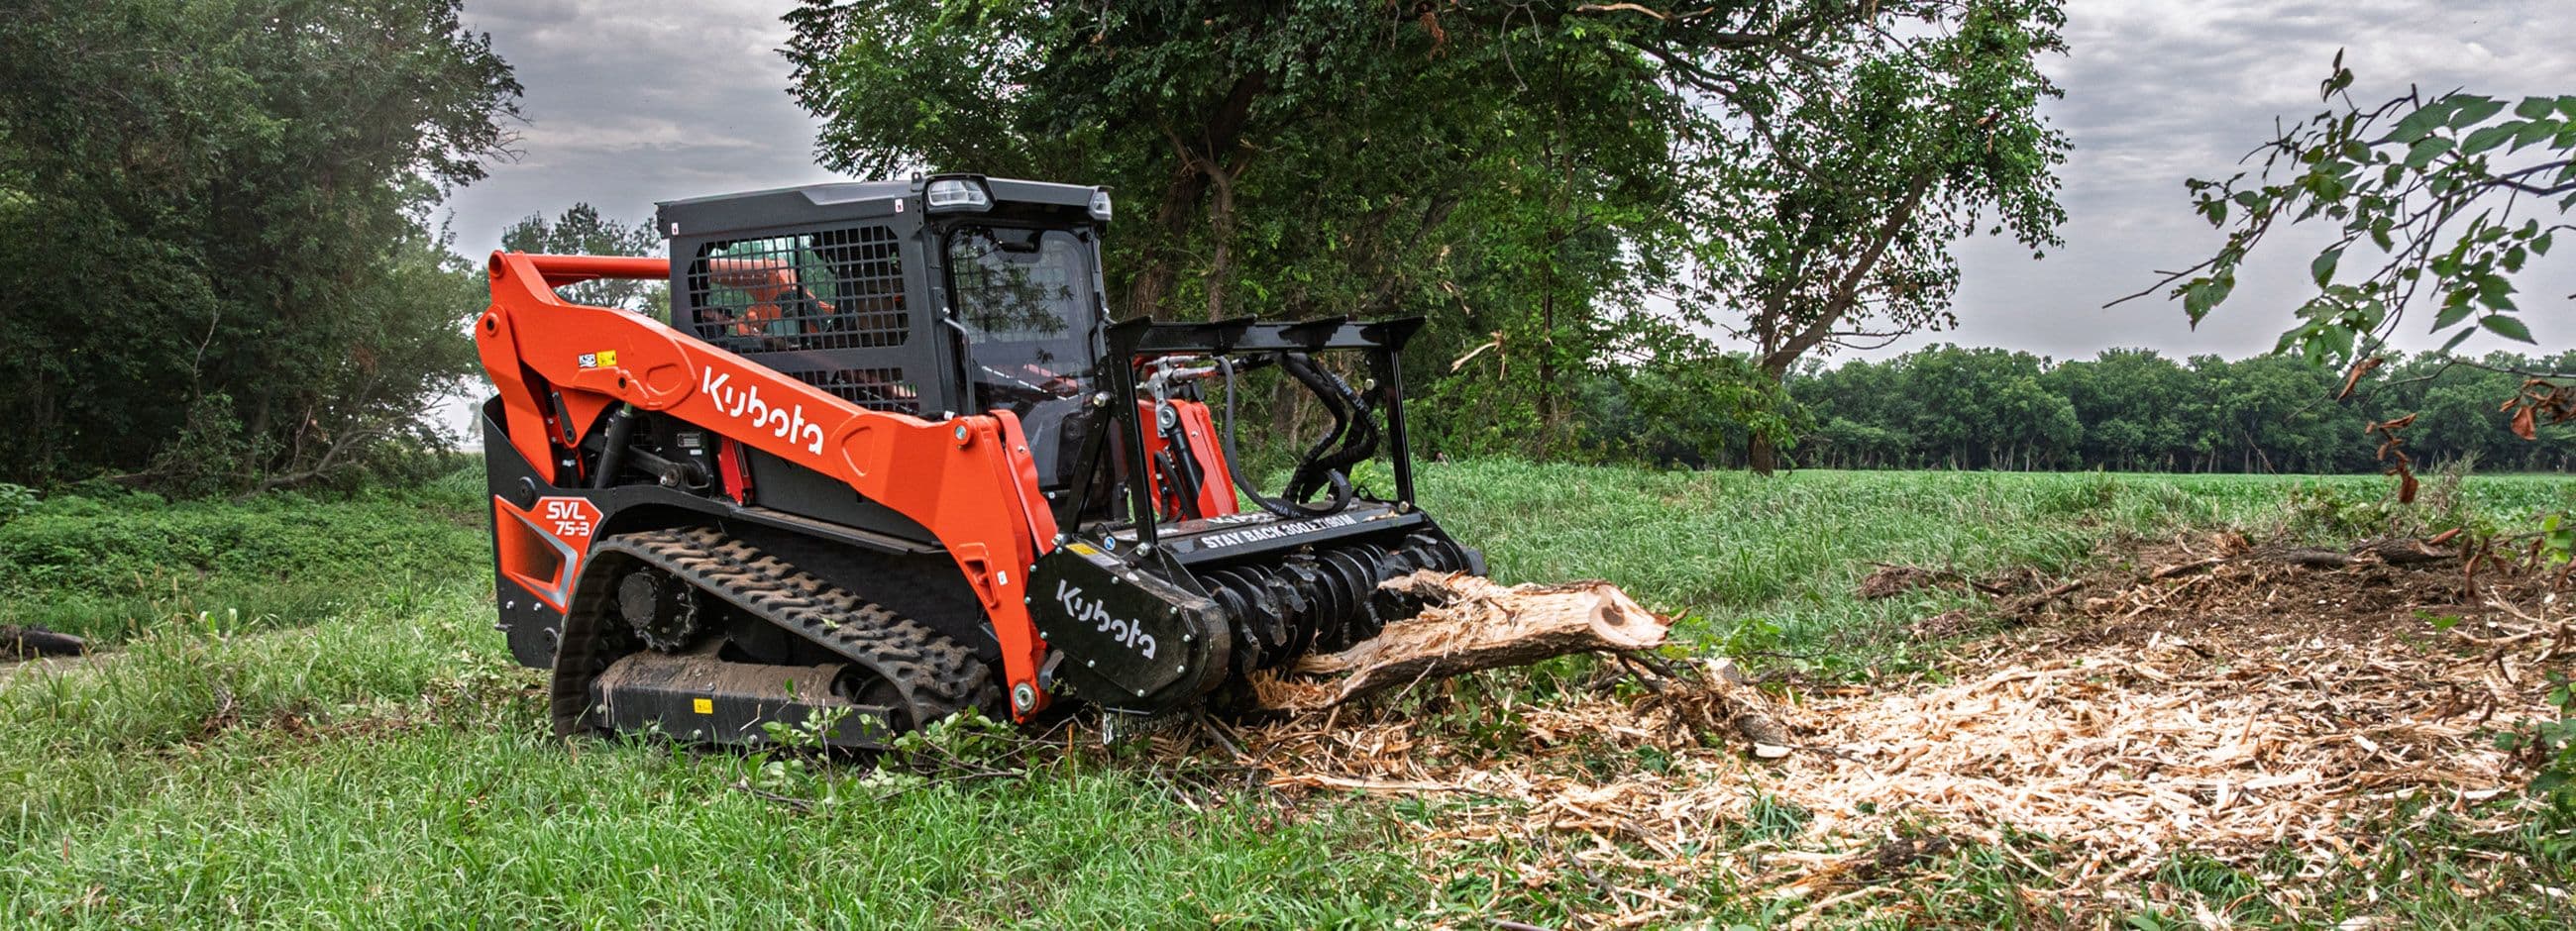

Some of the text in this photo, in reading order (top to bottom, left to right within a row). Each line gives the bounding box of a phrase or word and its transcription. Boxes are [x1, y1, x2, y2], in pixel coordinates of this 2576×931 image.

[701, 365, 824, 456] Kubota
[546, 501, 587, 520] SVL
[555, 521, 590, 536] 75-3
[1201, 532, 1243, 549] STAY
[1242, 526, 1287, 542] BACK
[1056, 578, 1156, 660] Kubota
